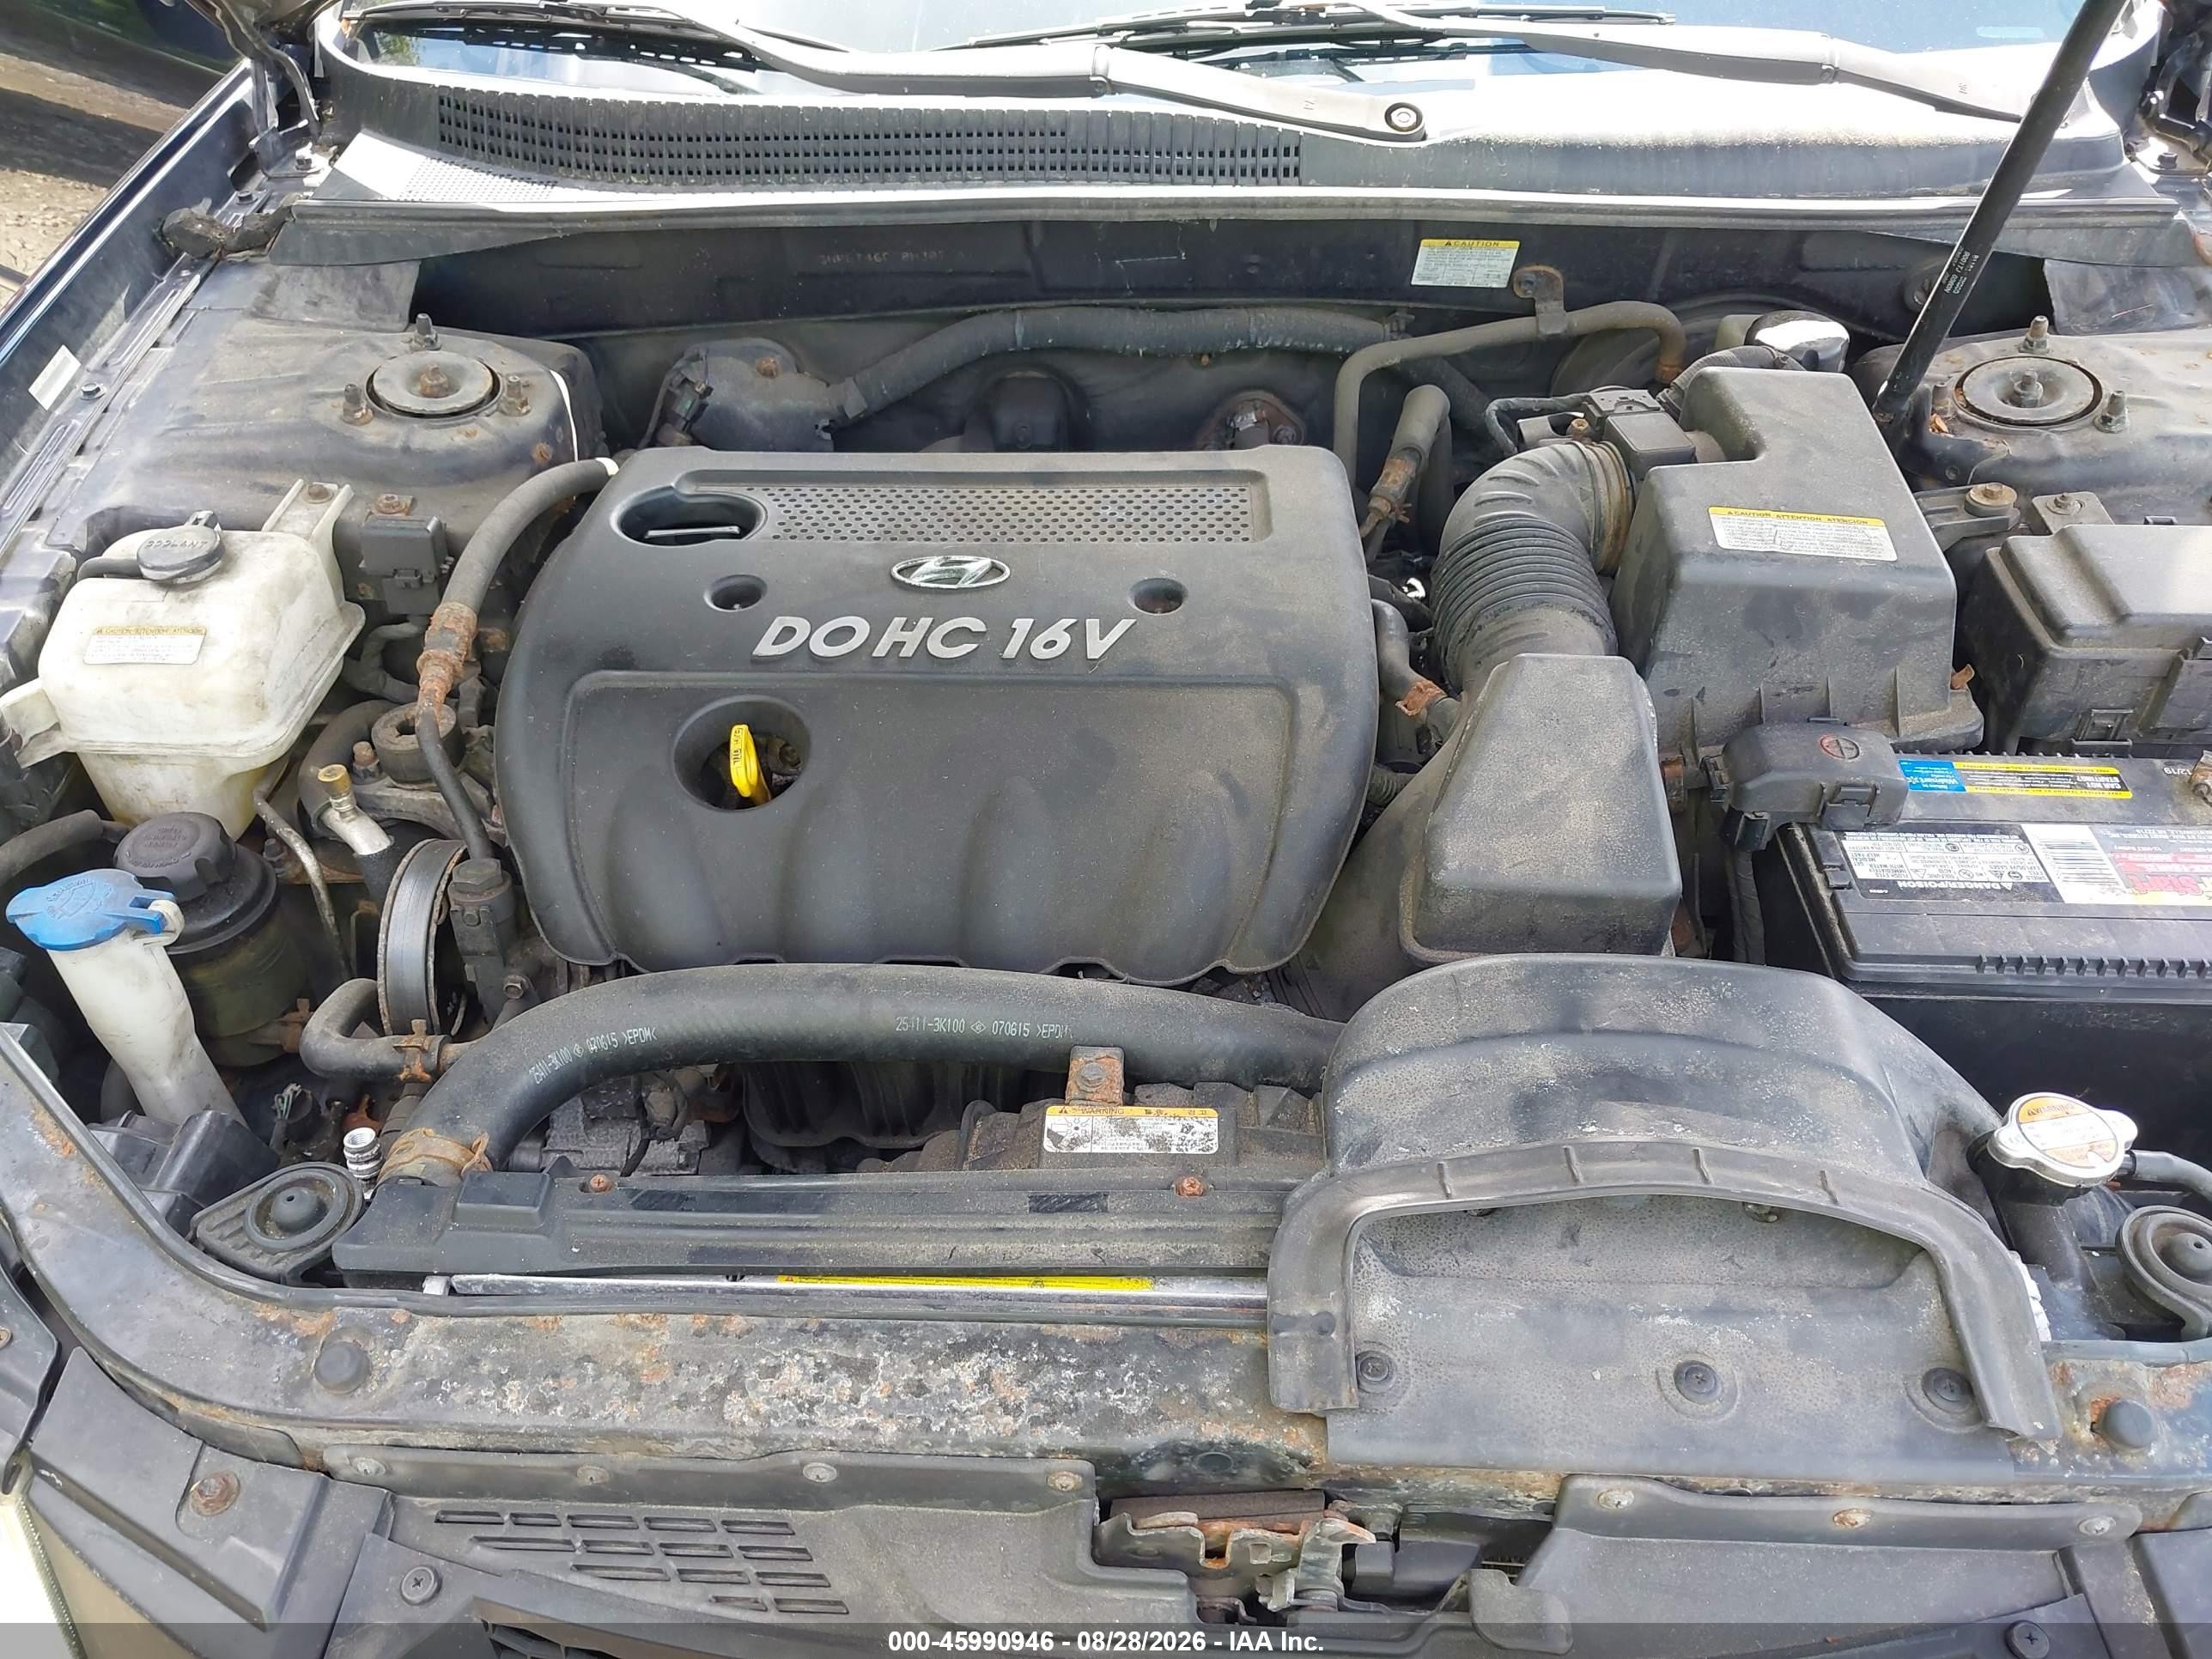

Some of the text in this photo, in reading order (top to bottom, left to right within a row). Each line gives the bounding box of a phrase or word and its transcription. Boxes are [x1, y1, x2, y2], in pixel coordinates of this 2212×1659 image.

[144, 540, 209, 549] COOLANT
[750, 616, 1137, 660] DOHC 16V
[1897, 880, 2002, 890] DANGER/POISON
[992, 1020, 1030, 1037] 070615
